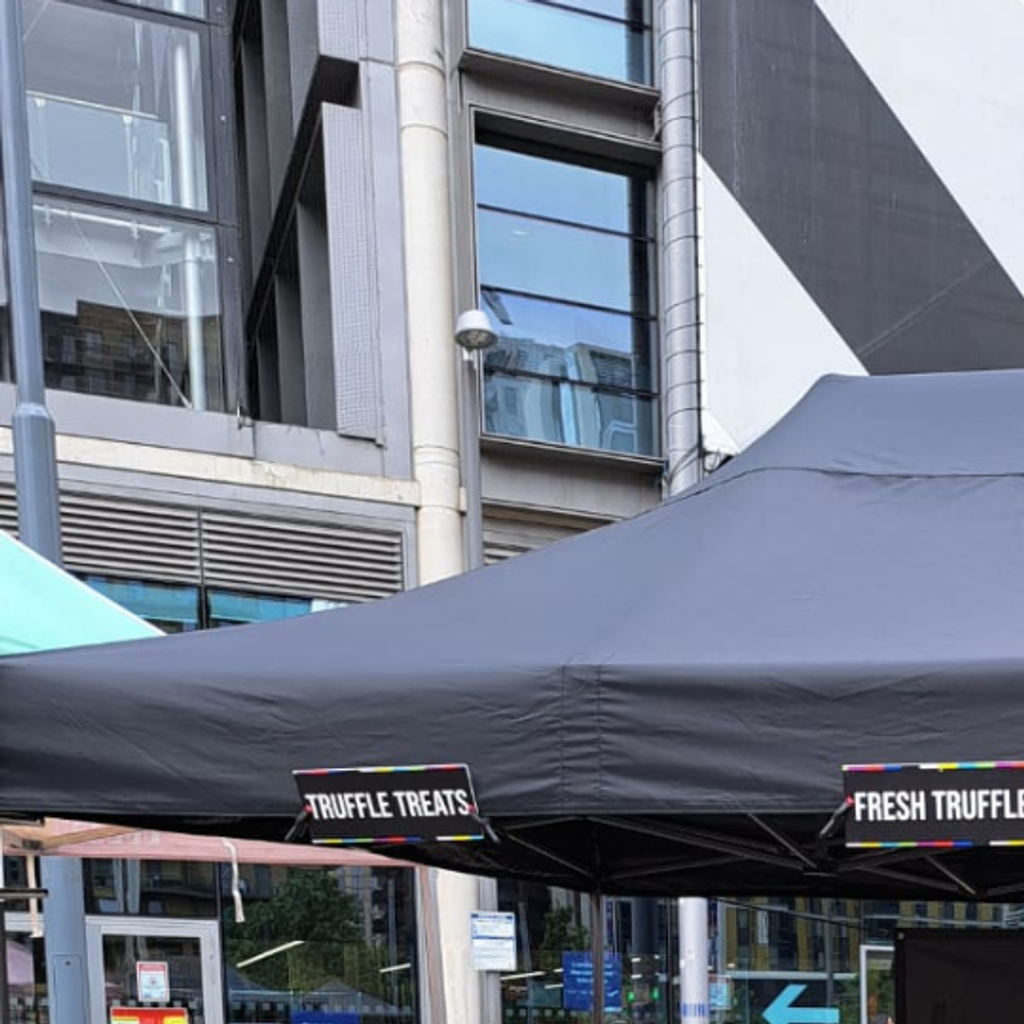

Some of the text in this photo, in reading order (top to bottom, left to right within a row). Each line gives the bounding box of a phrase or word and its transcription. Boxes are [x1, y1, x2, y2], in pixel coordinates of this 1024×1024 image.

[304, 789, 469, 820] TRUFFLE TREATS
[854, 790, 926, 821] FRESH
